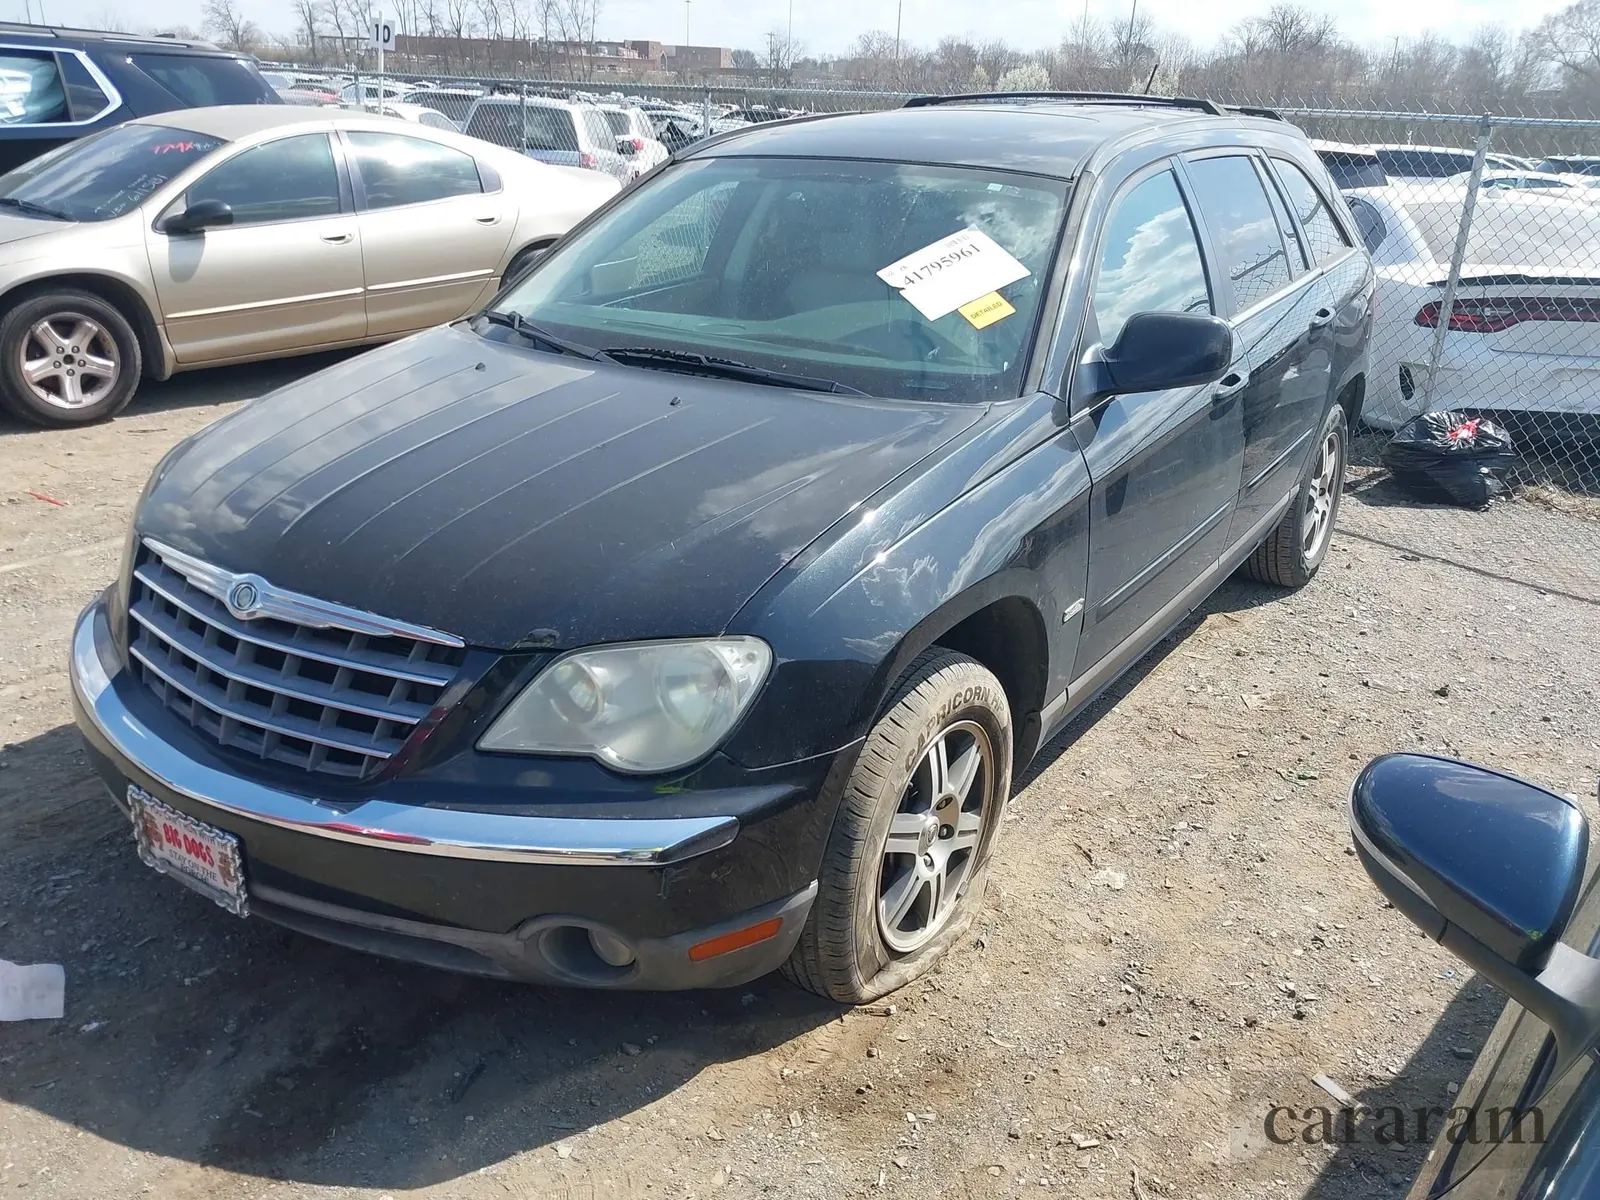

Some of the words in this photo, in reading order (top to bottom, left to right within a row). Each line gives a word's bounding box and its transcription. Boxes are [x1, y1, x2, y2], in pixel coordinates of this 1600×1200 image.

[374, 23, 391, 44] 10
[903, 243, 982, 286] 41795961
[970, 301, 1003, 319] DETAILED
[905, 686, 991, 773] CAPRICORN
[163, 823, 182, 849] BIG
[183, 834, 214, 867] DOGS
[169, 848, 186, 865] STAY
[201, 865, 218, 881] THE
